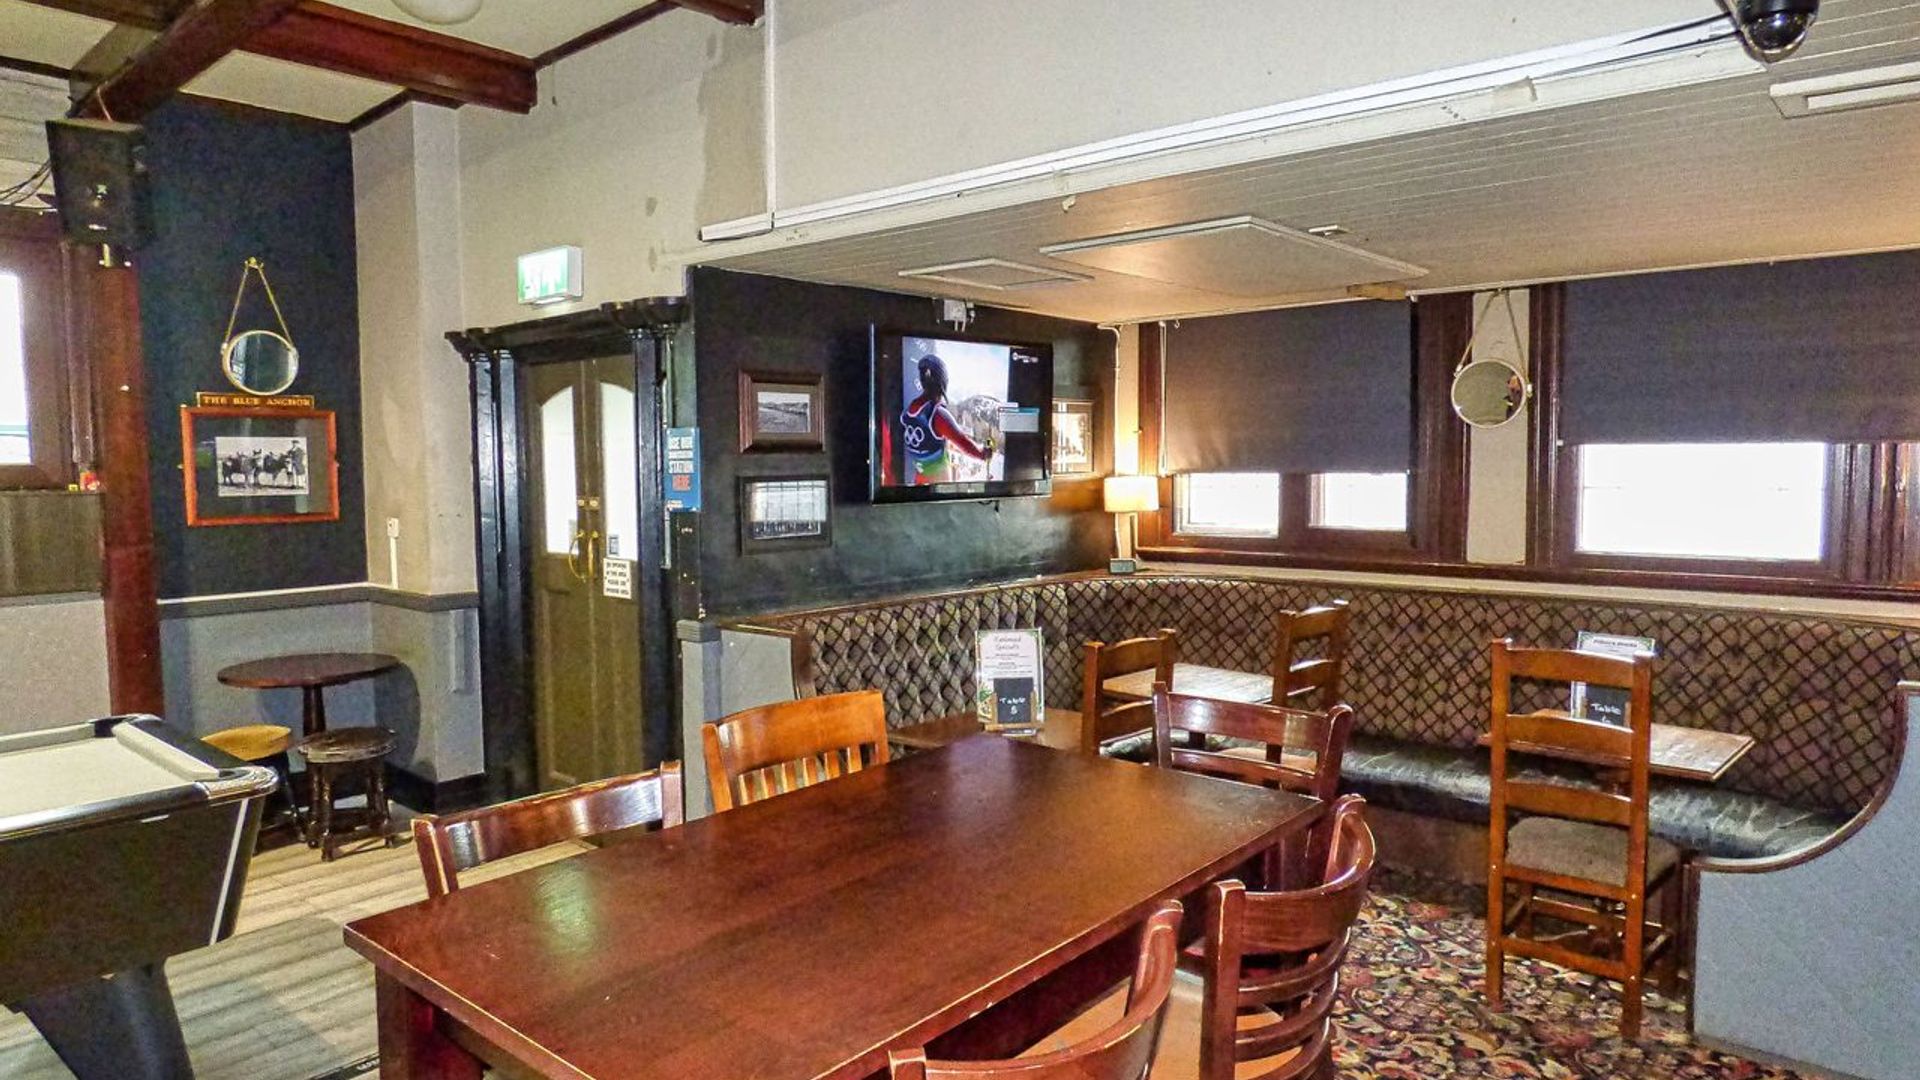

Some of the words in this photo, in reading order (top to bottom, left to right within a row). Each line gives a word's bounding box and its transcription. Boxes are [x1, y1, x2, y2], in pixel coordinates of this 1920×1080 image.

[202, 396, 228, 405] THE
[233, 397, 260, 406] BLUE
[266, 399, 311, 407] ANCHOR
[1590, 703, 1621, 715] Table
